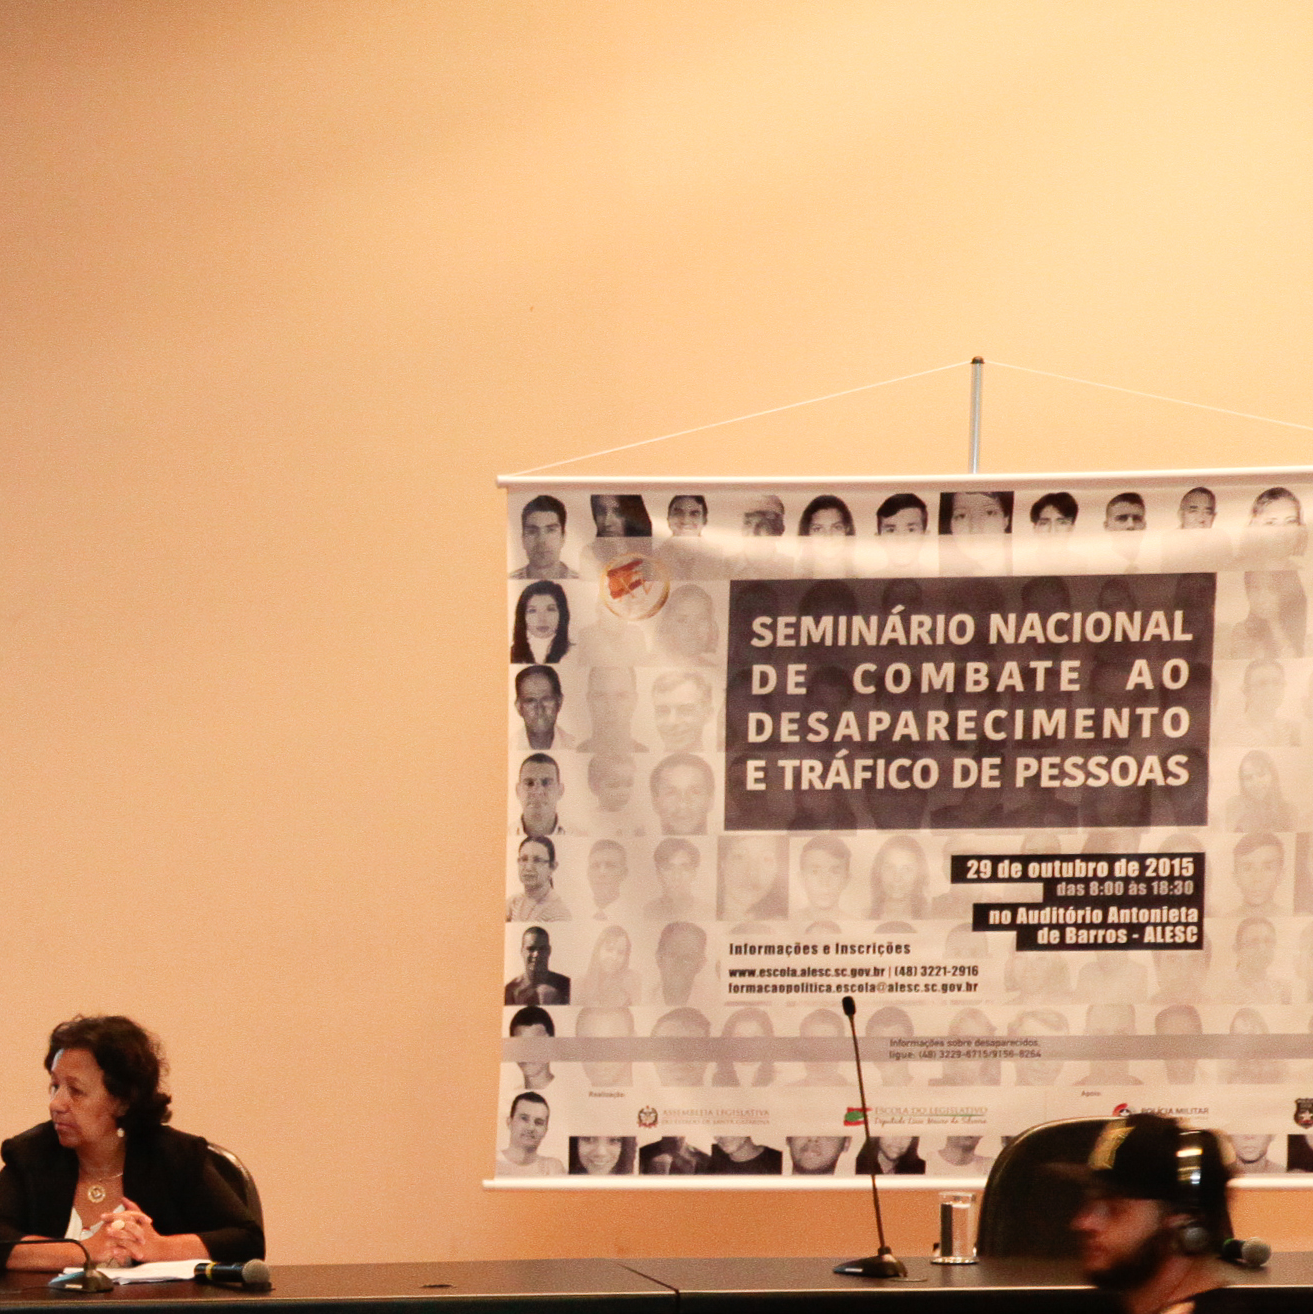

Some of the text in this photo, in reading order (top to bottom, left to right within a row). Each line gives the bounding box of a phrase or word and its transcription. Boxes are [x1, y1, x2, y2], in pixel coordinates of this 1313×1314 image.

[750, 604, 1193, 648] SEMINÁRIO NACIONAL
[751, 658, 1190, 695] DE COMBATE AO
[747, 706, 1190, 743] DESAPARECIMENTO
[746, 749, 1189, 791] E TRÁFICO DE PESSOAS
[966, 858, 1194, 878] 29 de outubro de 2015
[1057, 880, 1193, 896] das 8:00 às 18:30
[989, 906, 1198, 924] no Auditório Antonieta
[1037, 928, 1060, 944] de
[1065, 927, 1127, 943] Barros
[1143, 926, 1198, 943] ALESC
[729, 942, 911, 957] Informações e Inscrições
[729, 965, 978, 978] www.escola.alesc.sc.gov.br (48) 3221-2916
[890, 1039, 972, 1048] Informações sobre
